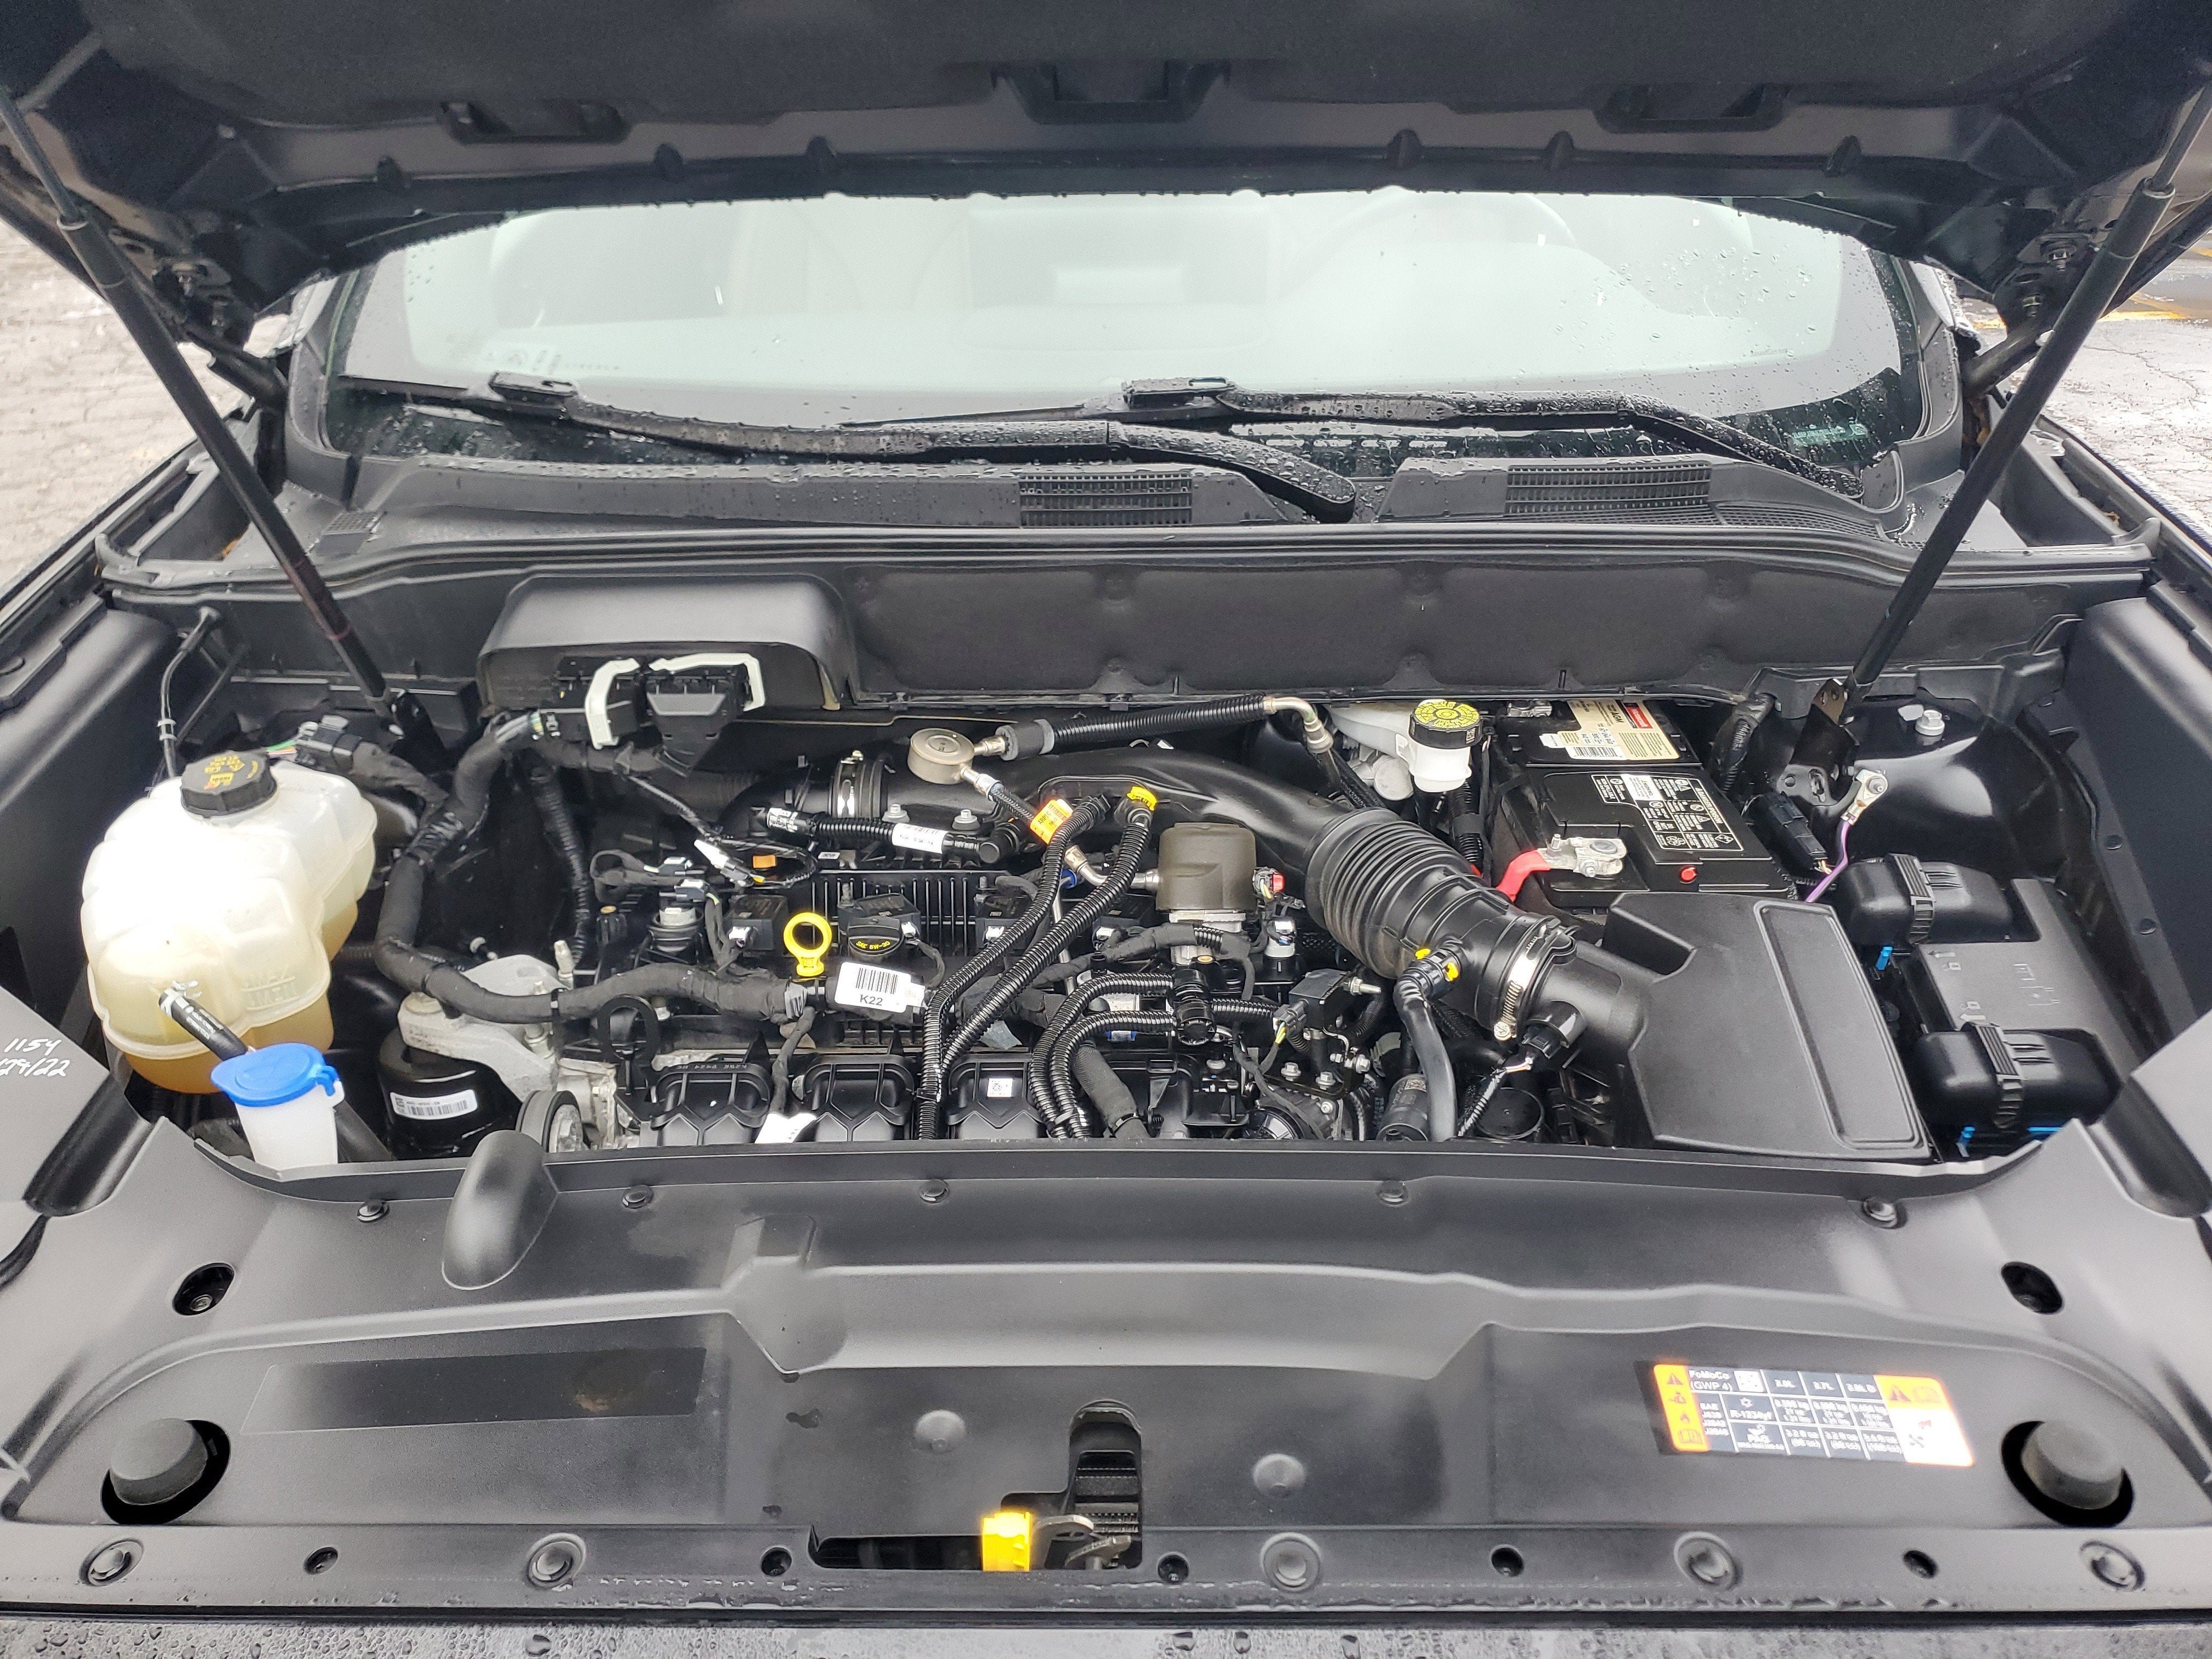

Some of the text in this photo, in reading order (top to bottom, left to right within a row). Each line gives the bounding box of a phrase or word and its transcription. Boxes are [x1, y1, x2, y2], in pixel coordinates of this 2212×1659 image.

[1611, 712, 1624, 723] AGM
[860, 994, 883, 1006] K22
[1689, 1370, 1730, 1379] FoMoCo
[1690, 1380, 1720, 1390] (GWP
